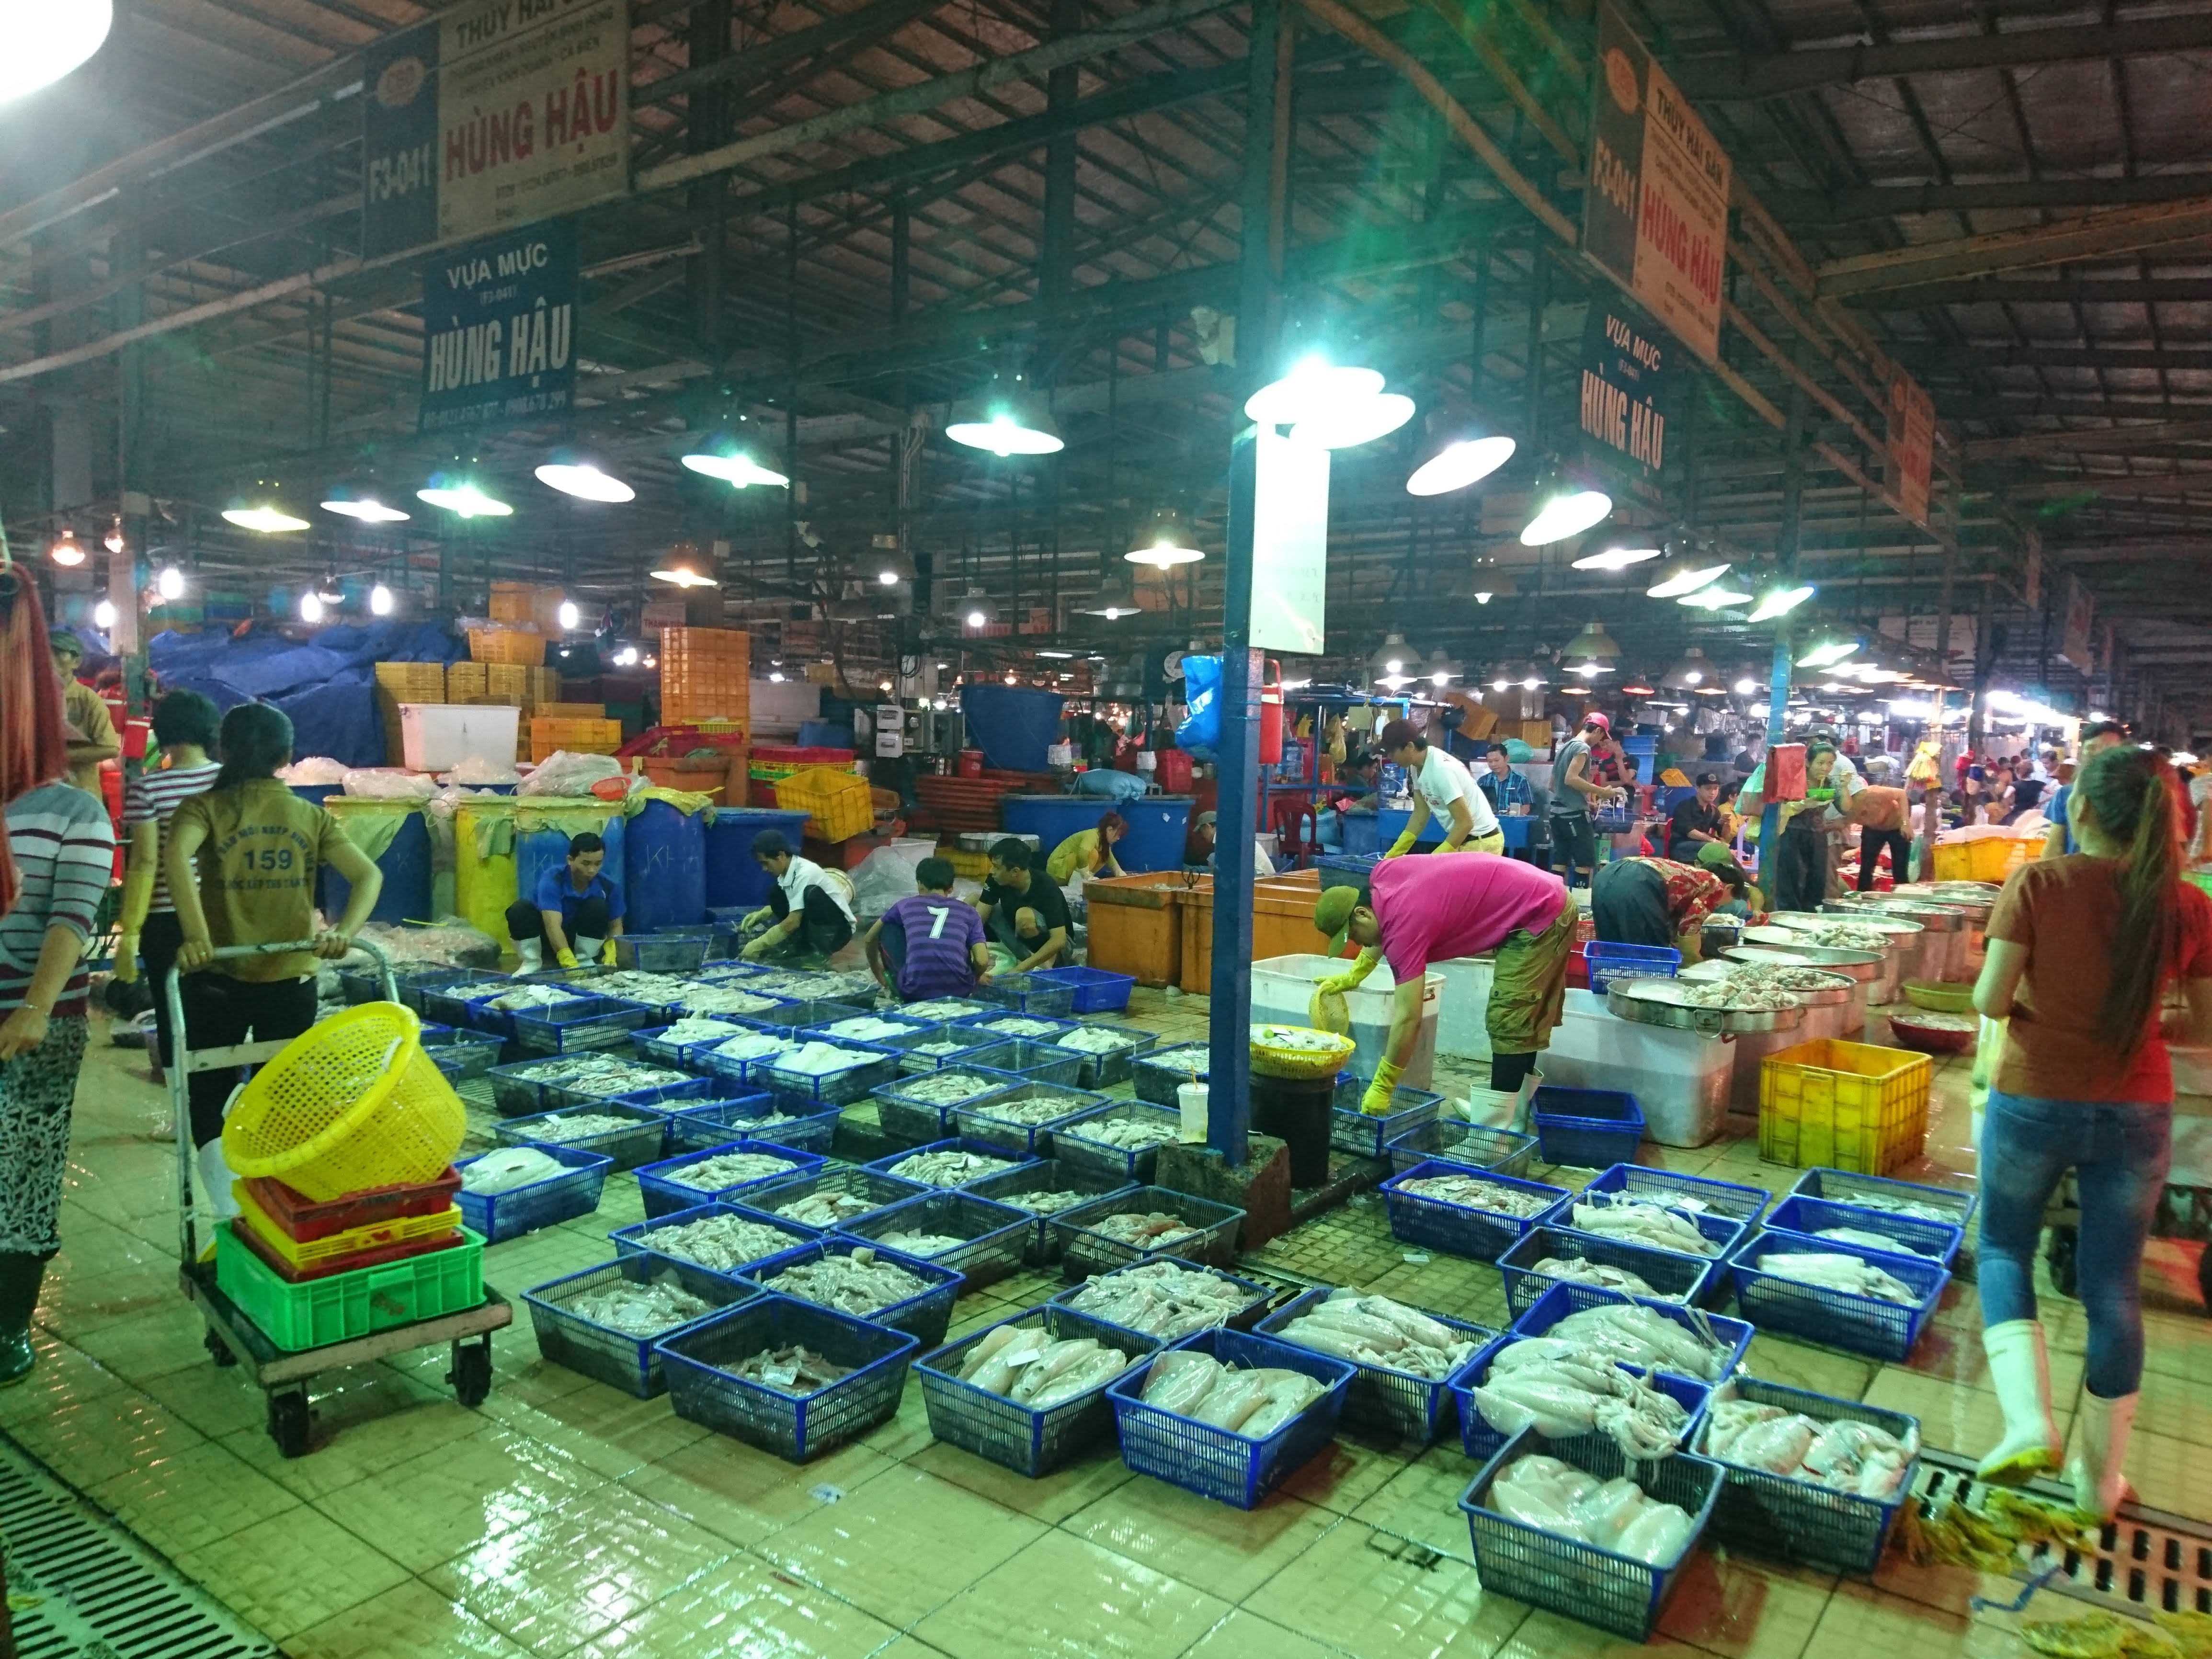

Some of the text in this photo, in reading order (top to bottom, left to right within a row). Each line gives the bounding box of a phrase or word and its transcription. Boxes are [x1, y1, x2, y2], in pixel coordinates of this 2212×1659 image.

[445, 101, 533, 182] HÙNG
[545, 67, 618, 154] HẬU
[1642, 183, 1688, 273] HÙNG
[447, 243, 548, 290] VỰA MỰC
[429, 296, 571, 392] HÙNG HẬU
[1633, 336, 1661, 371] MỰC
[1581, 363, 1665, 477] HÙNG HẬU
[243, 849, 293, 870] 159
[927, 906, 949, 939] 7
